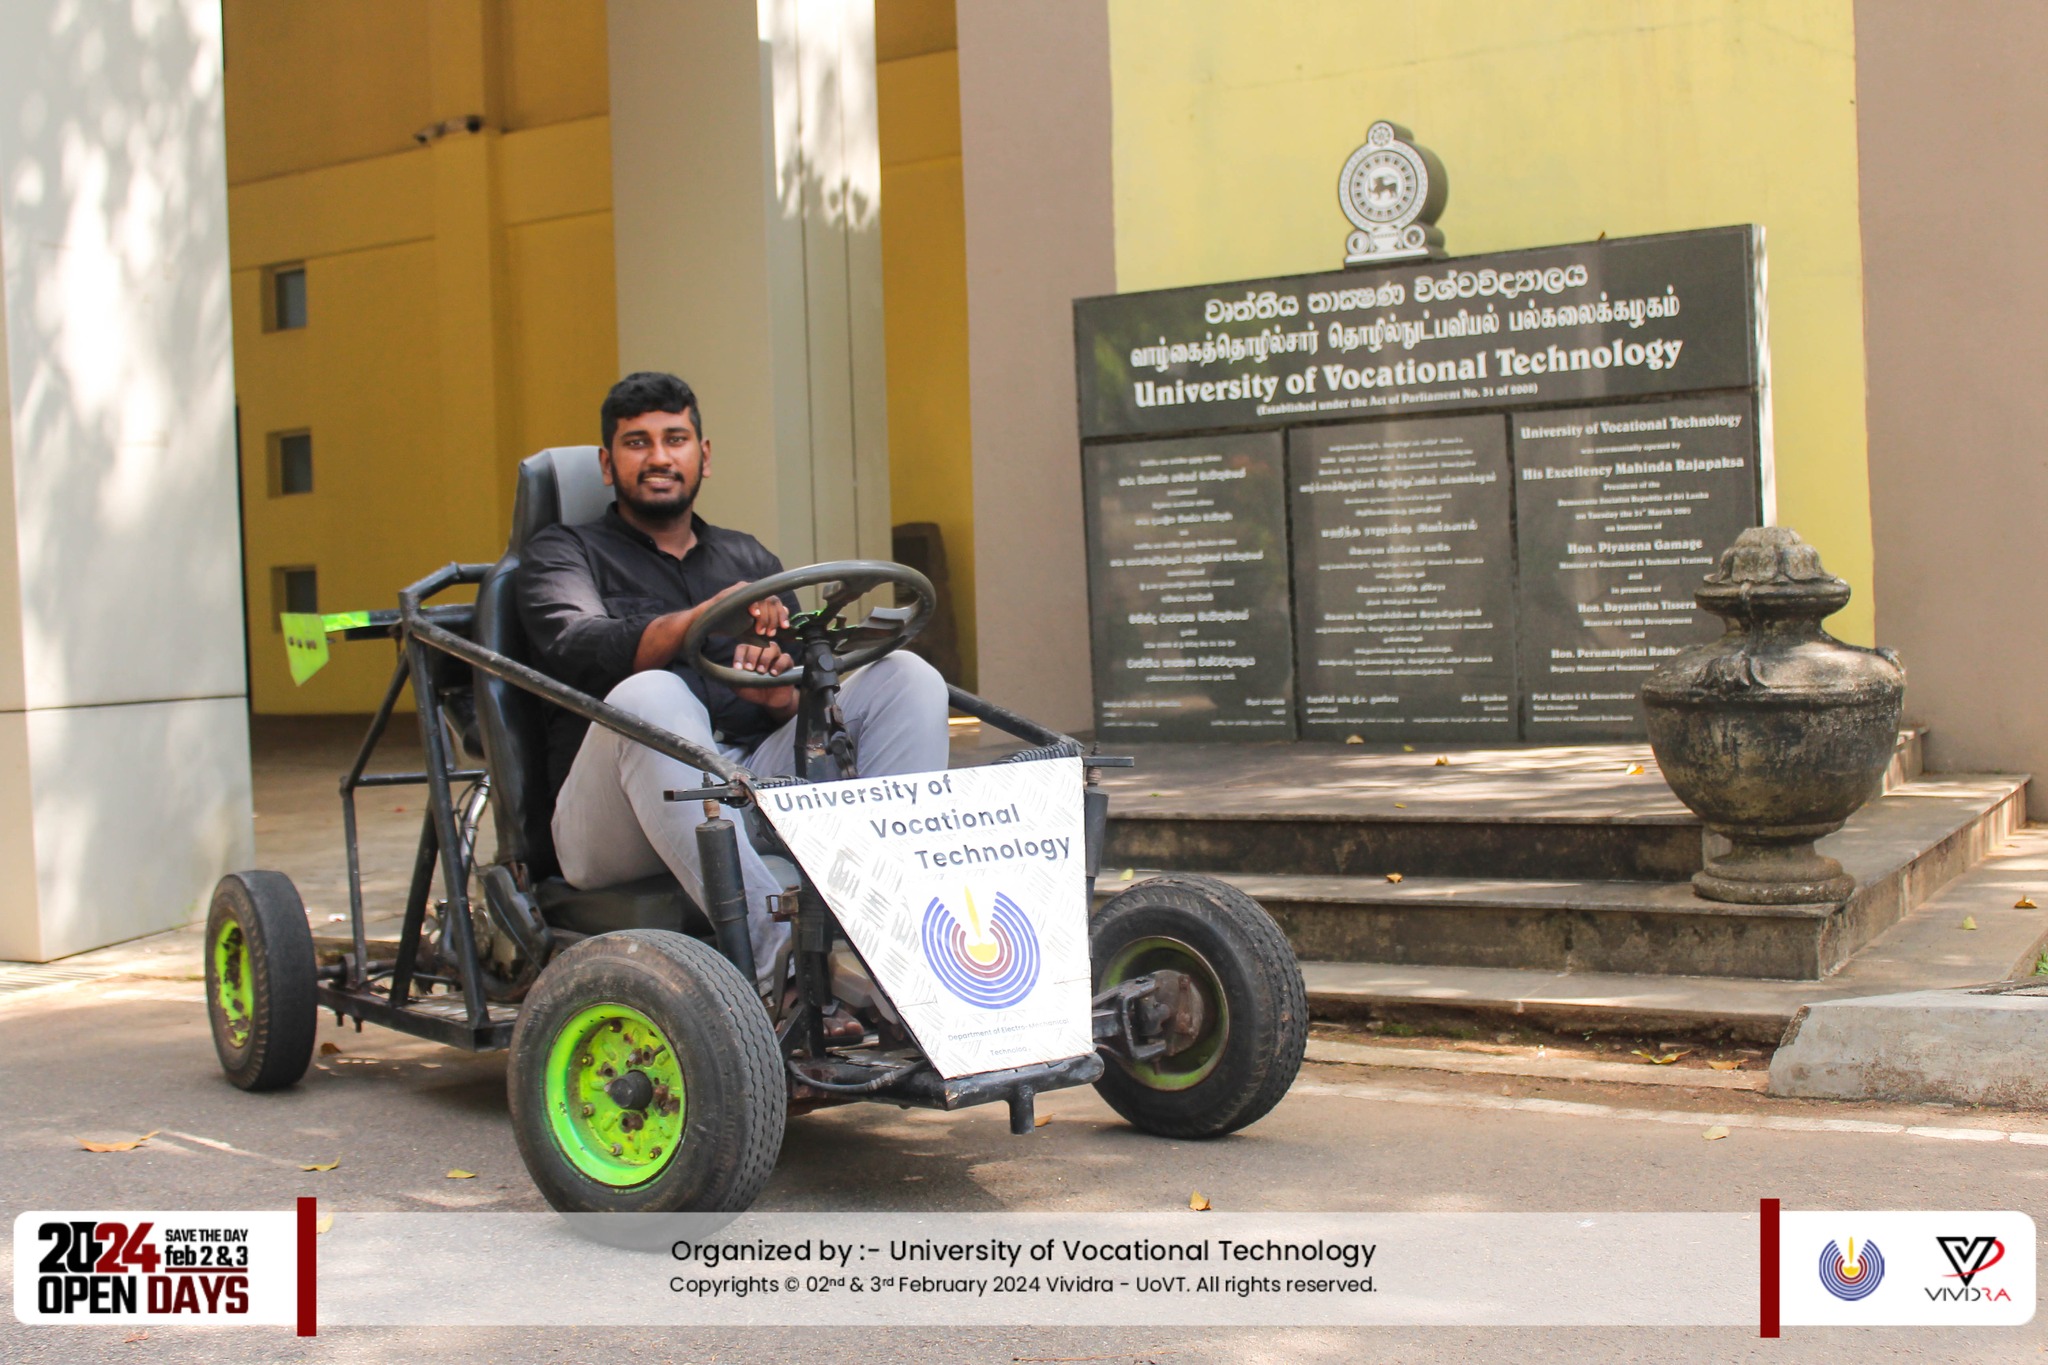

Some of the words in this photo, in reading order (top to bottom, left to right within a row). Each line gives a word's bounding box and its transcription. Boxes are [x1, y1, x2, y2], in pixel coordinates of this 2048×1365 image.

[1508, 284, 1680, 329] பல்கலைக்கழகம்
[1133, 373, 1279, 407] University
[1285, 365, 1317, 395] of
[1322, 350, 1487, 391] Vocational
[1495, 338, 1683, 376] Technology
[1318, 398, 1349, 410] under
[1350, 397, 1368, 408] the
[1369, 395, 1387, 406] Act
[1387, 393, 1400, 405] of
[1401, 390, 1460, 404] Parliament
[1462, 387, 1480, 399] No.
[1482, 386, 1494, 397] 31
[1496, 384, 1509, 396] of
[1520, 425, 1583, 439] University
[1584, 422, 1599, 435] of
[1600, 417, 1667, 433] Vocational
[1669, 414, 1742, 429] Technology
[1669, 440, 1682, 450] by
[1522, 468, 1543, 480] His
[1545, 465, 1612, 479] Excellency
[1615, 460, 1672, 475] Mahinda
[1675, 456, 1744, 472] Rajapaksa
[1603, 482, 1638, 491] President
[1639, 481, 1647, 489] of
[1648, 480, 1660, 488] the
[1664, 492, 1672, 501] of
[1673, 492, 1684, 500] Sri
[1587, 511, 1618, 519] Tuesday
[1619, 510, 1633, 518] the
[1653, 522, 1662, 530] of
[1567, 542, 1596, 554] Hon.
[1598, 541, 1651, 554] Piyasena
[1653, 538, 1703, 551] Gamage
[1628, 572, 1643, 580] and
[1652, 584, 1662, 592] of
[1577, 602, 1602, 613] Hon.
[1603, 601, 1659, 613] Dayasritha
[1660, 600, 1697, 610] Tissera
[1614, 618, 1622, 626] of
[1630, 631, 1645, 639] and
[1551, 648, 1575, 658] Hon.
[774, 780, 917, 812] University
[928, 774, 953, 795] of
[869, 803, 1020, 838] Vocational
[914, 836, 1069, 869] Technology
[947, 1028, 992, 1041] Department
